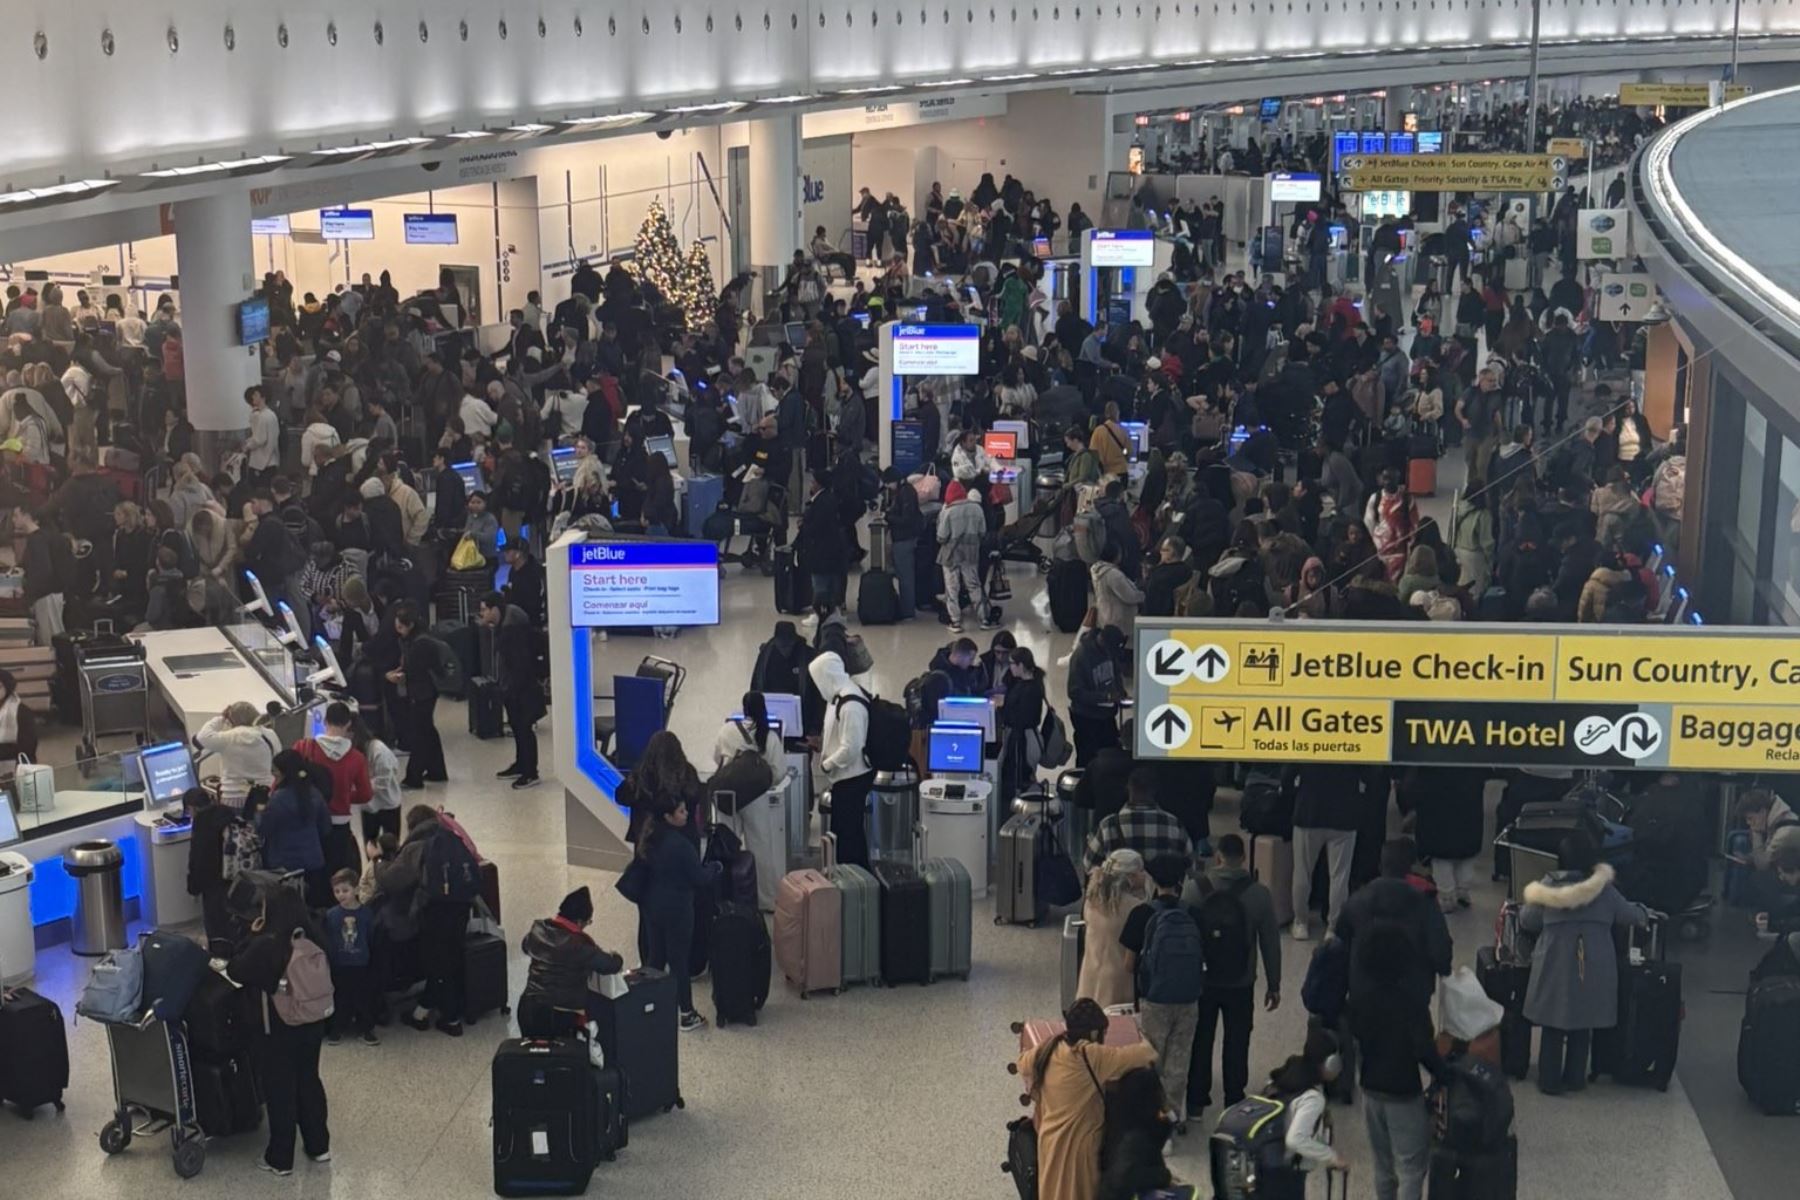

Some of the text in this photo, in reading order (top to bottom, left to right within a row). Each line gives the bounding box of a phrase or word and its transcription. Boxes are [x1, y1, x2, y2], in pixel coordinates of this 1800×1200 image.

[1380, 159, 1446, 168] JetBlue Check-in
[1451, 160, 1466, 168] Sun
[1503, 160, 1522, 169] Cape
[1524, 160, 1536, 168] Air
[1370, 175, 1409, 184] All Gates
[1414, 176, 1444, 186] Priority
[1446, 176, 1480, 186] Security
[1490, 176, 1506, 184] TSA
[898, 326, 926, 337] jetBlue
[899, 343, 938, 351] Start here
[582, 546, 626, 563] jetBlue
[583, 573, 648, 586] Start here
[583, 600, 648, 610] Comenzar aquí
[1290, 652, 1545, 682] JetBlue Check-in
[1568, 656, 1622, 683] Sun
[1632, 657, 1759, 691] Country,
[1252, 705, 1384, 734] All Gates
[1405, 718, 1565, 747] TWA Hotel
[1252, 739, 1361, 755] Todas las puertas
